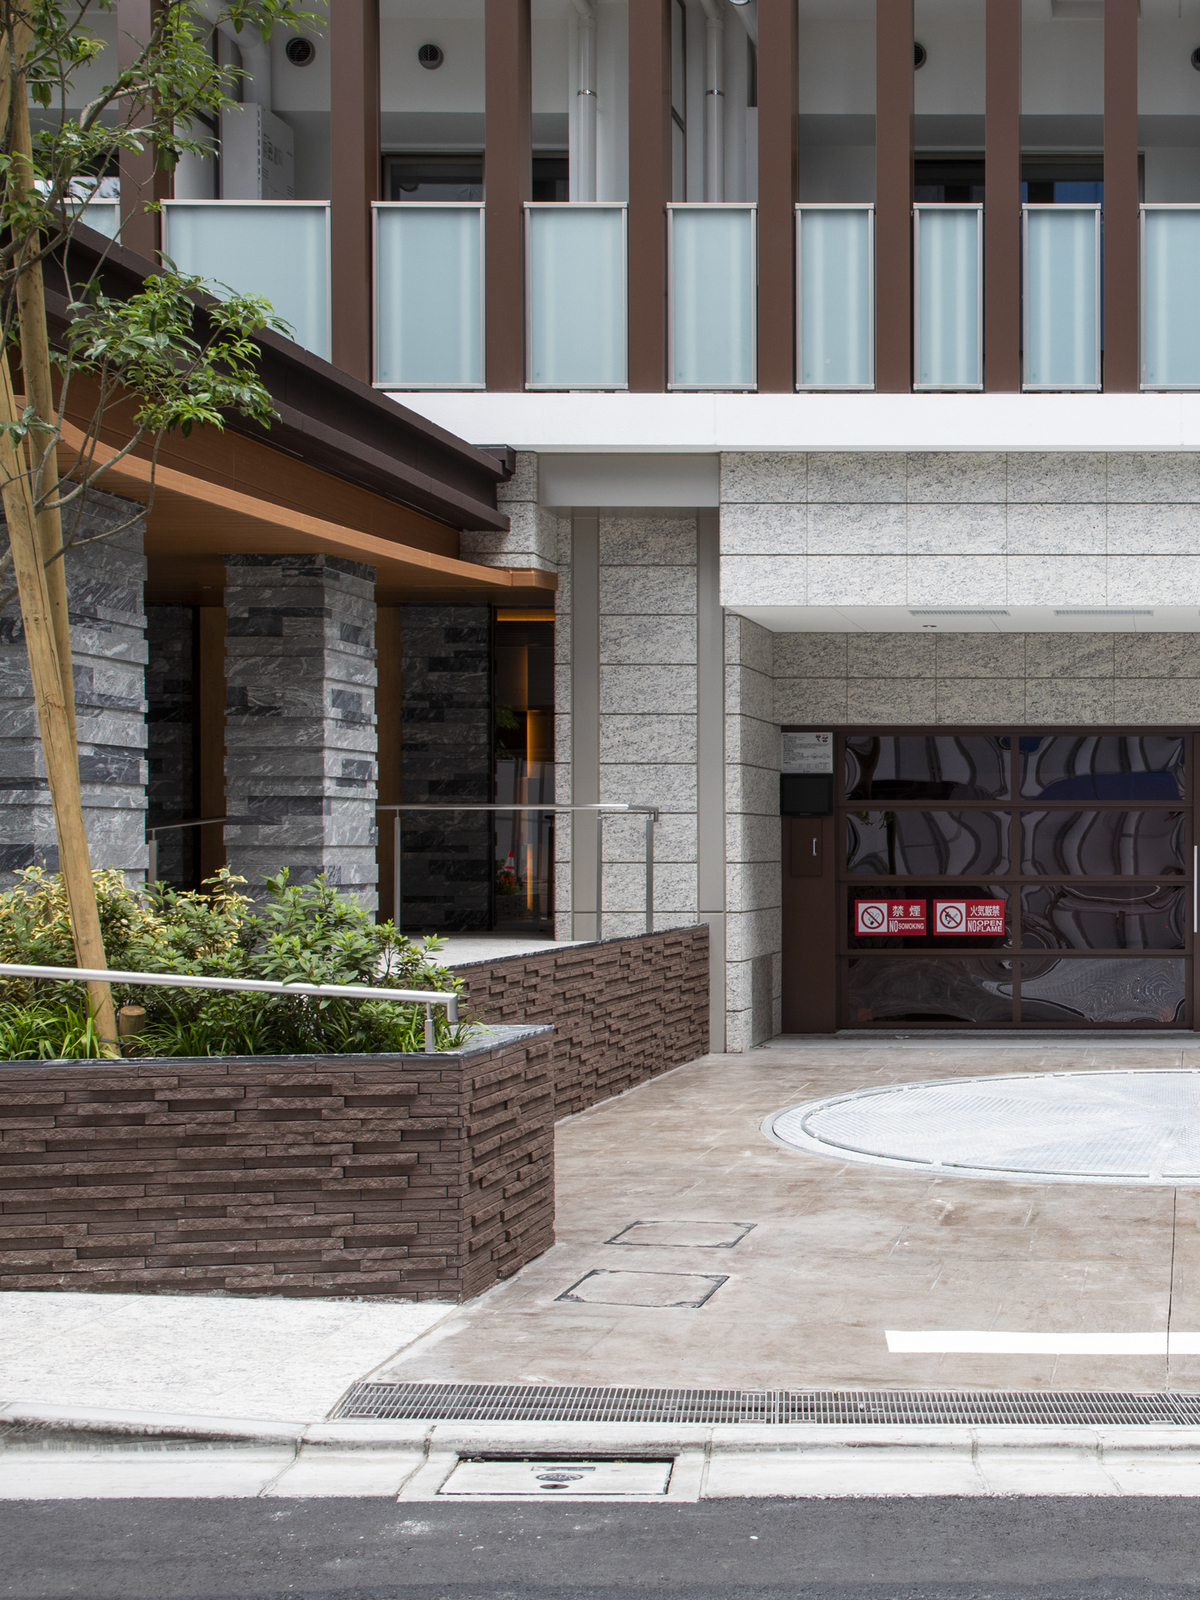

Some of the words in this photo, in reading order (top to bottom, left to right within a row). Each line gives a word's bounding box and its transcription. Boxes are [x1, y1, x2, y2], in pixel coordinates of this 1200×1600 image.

[892, 905, 921, 917] 禁煙
[970, 905, 1000, 917] 火気厳禁
[889, 920, 899, 933] NO
[967, 920, 977, 933] NO
